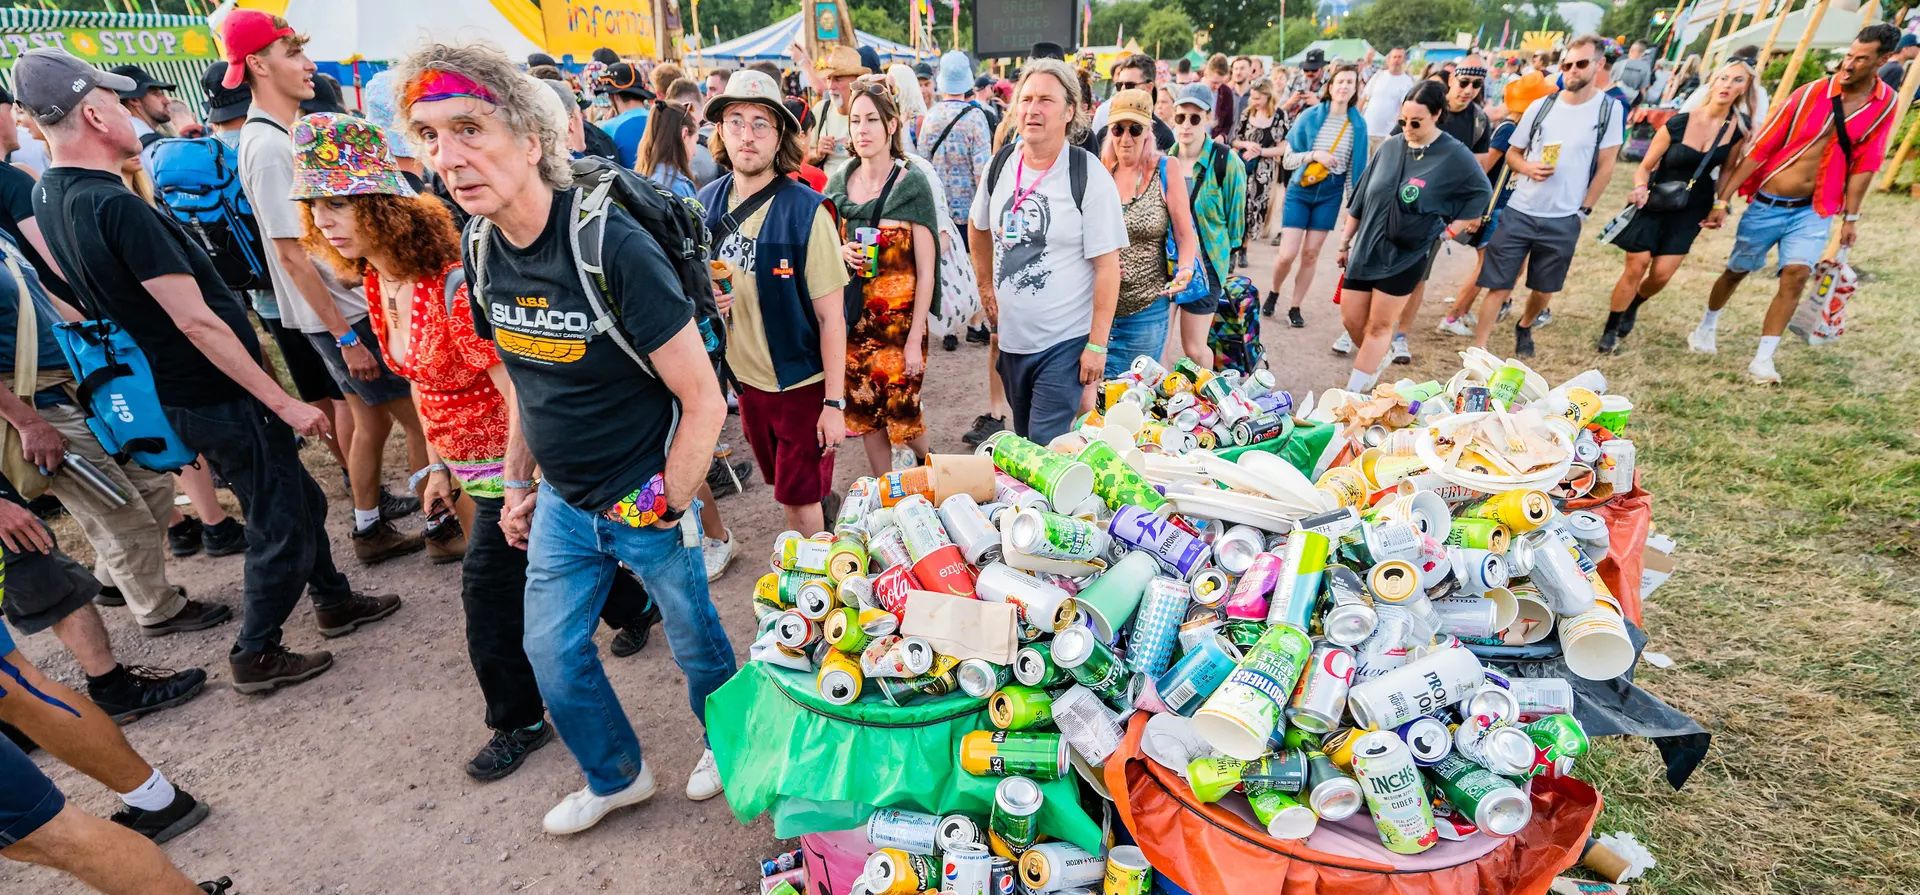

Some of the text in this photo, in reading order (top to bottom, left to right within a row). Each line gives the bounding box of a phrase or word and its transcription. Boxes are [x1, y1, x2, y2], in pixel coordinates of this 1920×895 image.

[99, 30, 177, 56] STOP
[71, 78, 87, 94] Gill
[491, 302, 588, 332] SULACO
[110, 393, 134, 423] Gill
[1126, 608, 1150, 666] LAGER
[1264, 654, 1295, 675] APPLE
[1388, 693, 1404, 718] HOPPED
[1412, 692, 1432, 715] JOB
[1369, 765, 1416, 794] INCH'S
[1391, 797, 1414, 810] CIDER
